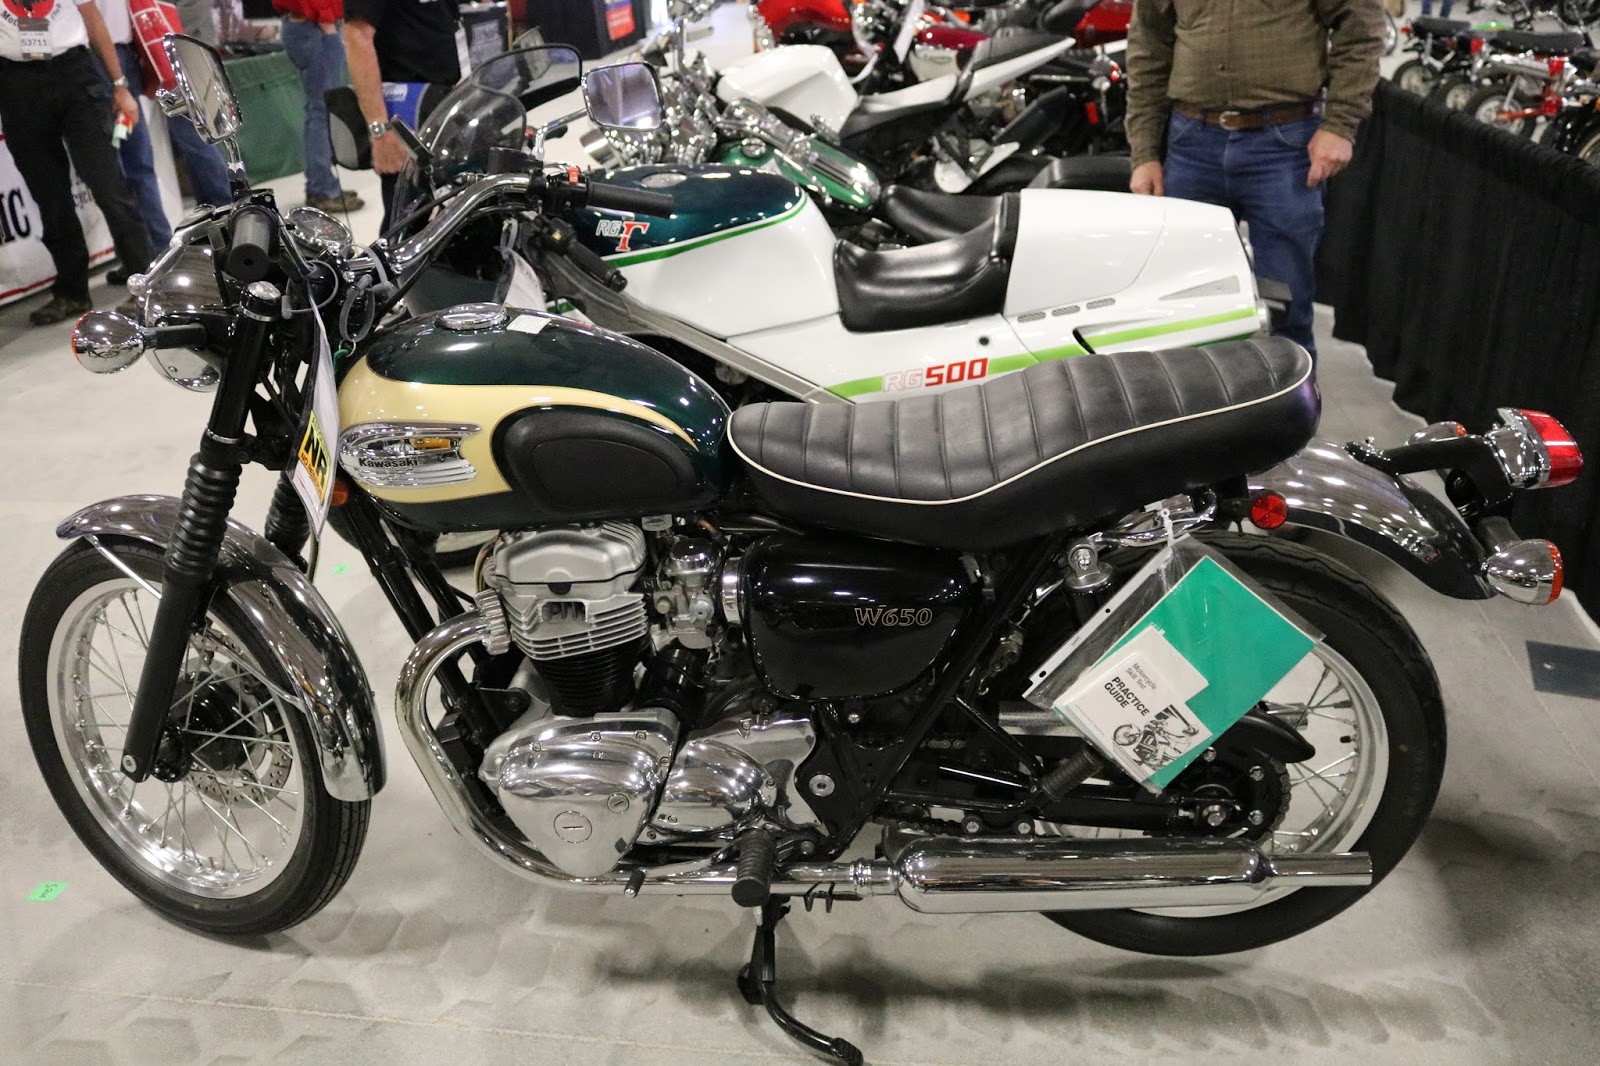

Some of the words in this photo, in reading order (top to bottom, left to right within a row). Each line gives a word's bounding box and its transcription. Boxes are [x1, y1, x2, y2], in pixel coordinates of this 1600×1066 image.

[359, 457, 419, 468] Kawasaki
[854, 607, 933, 627] W650
[1125, 667, 1138, 680] Skill
[1136, 678, 1147, 690] Test
[1132, 662, 1157, 690] Motorcycle
[1104, 682, 1130, 709] GUIDE
[1111, 676, 1150, 717] PRACTICE
